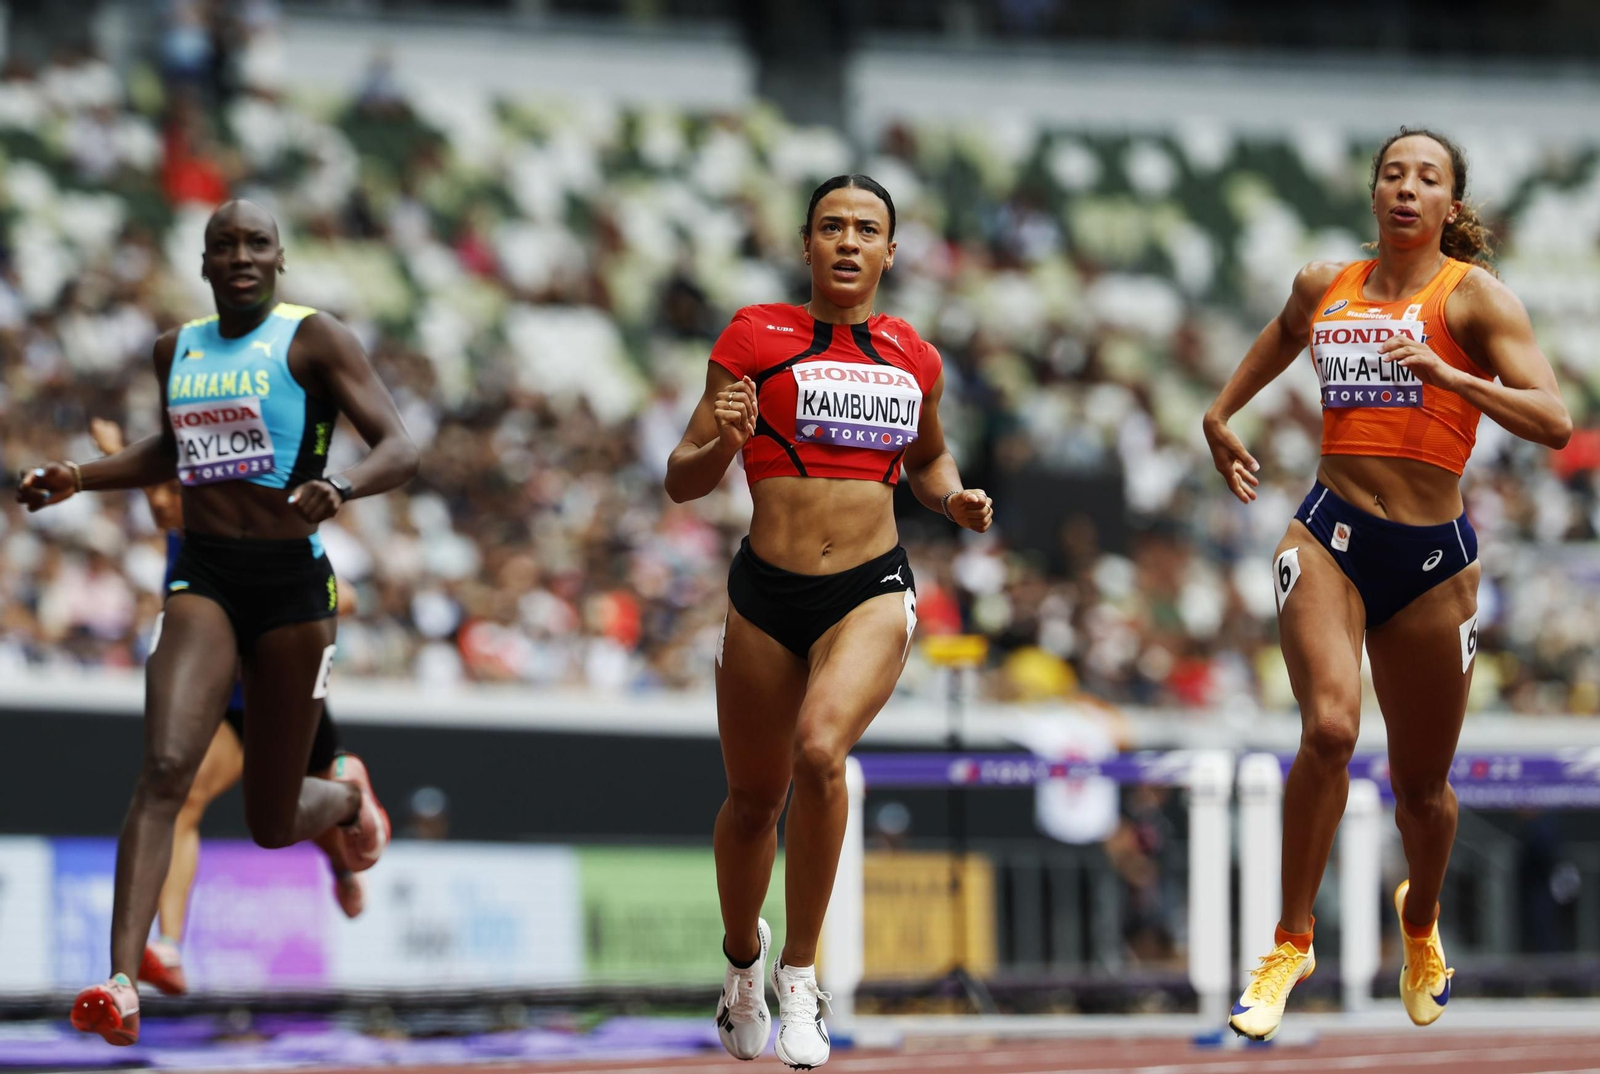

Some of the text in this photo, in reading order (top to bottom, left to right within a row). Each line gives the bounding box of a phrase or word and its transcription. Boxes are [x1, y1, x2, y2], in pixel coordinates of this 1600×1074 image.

[1314, 328, 1416, 346] HONDA
[171, 369, 271, 400] BAHAMAS
[797, 367, 917, 390] HONDA
[802, 389, 916, 427] KAMBUNDJI
[1278, 556, 1291, 593] 6
[1466, 617, 1478, 656] 6
